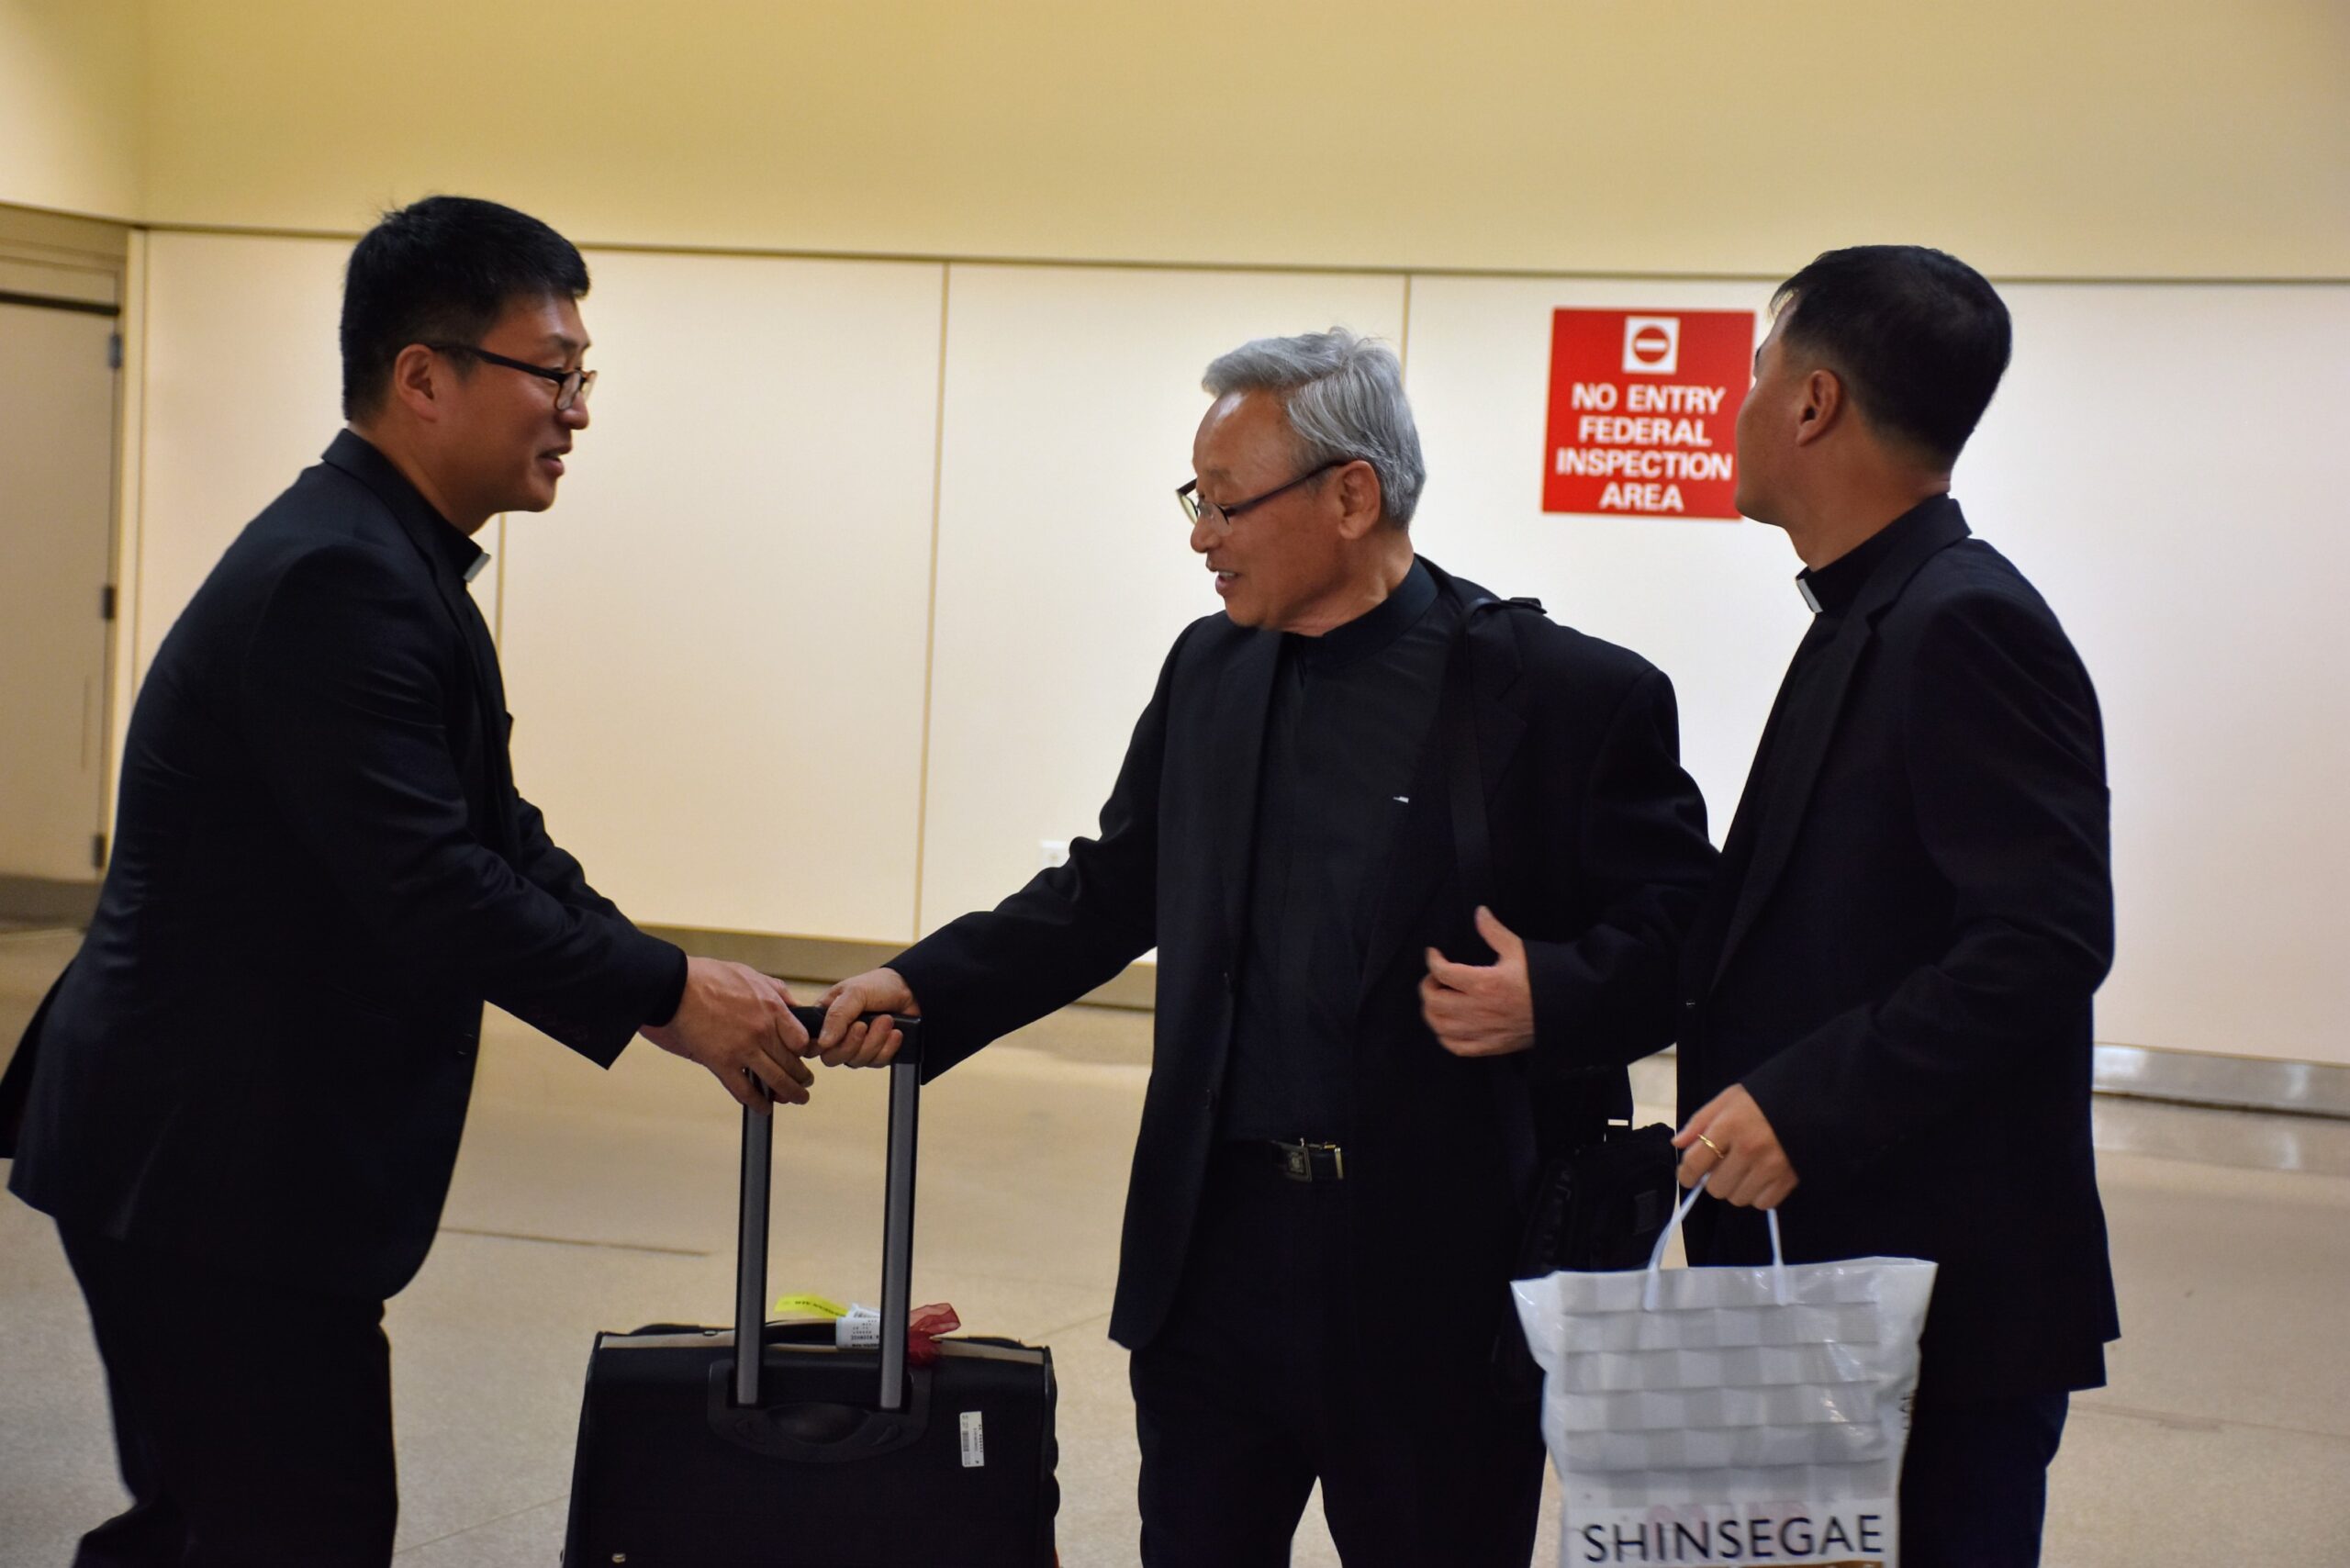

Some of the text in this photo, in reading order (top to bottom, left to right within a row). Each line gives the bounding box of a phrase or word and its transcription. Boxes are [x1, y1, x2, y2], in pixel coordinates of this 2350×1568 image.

[1572, 383, 1726, 414] NO ENTRY
[1579, 416, 1712, 446] FEDERAL
[1556, 447, 1732, 480] INSPECTION
[1599, 482, 1684, 511] AREA
[1583, 1515, 1885, 1562] SHINSEGAE
